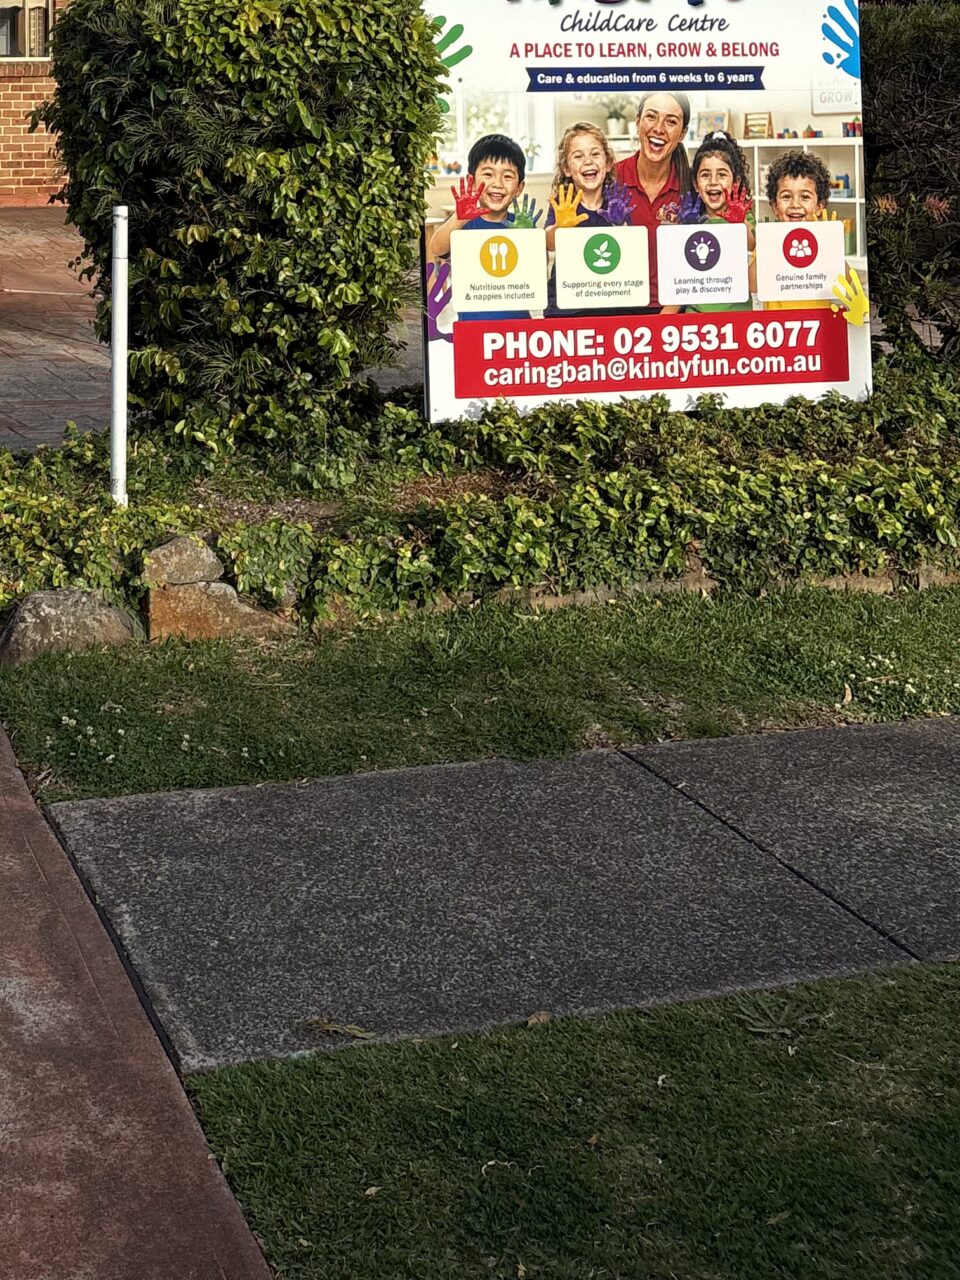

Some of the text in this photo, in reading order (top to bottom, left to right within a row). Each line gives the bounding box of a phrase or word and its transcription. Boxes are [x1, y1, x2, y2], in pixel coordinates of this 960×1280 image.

[560, 9, 730, 32] ChildCare Centre
[509, 42, 780, 61] A PLACE TO LEARN, GROW & BELONG
[537, 72, 755, 84] Care & education from 6 weeks to 6 years
[819, 89, 853, 104] GROW
[673, 276, 733, 286] Learning through
[775, 272, 828, 282] Genuine family
[469, 282, 530, 291] Nutritious meals
[561, 279, 644, 290] Supporting every stage
[675, 285, 732, 295] play & discovery
[780, 282, 824, 291] partnerships
[464, 291, 536, 302] & nappies included
[575, 289, 632, 298] of development
[483, 320, 821, 360] PHONE: 02 9531 6077
[483, 354, 822, 388] caringbah@kindyfun.com.au
